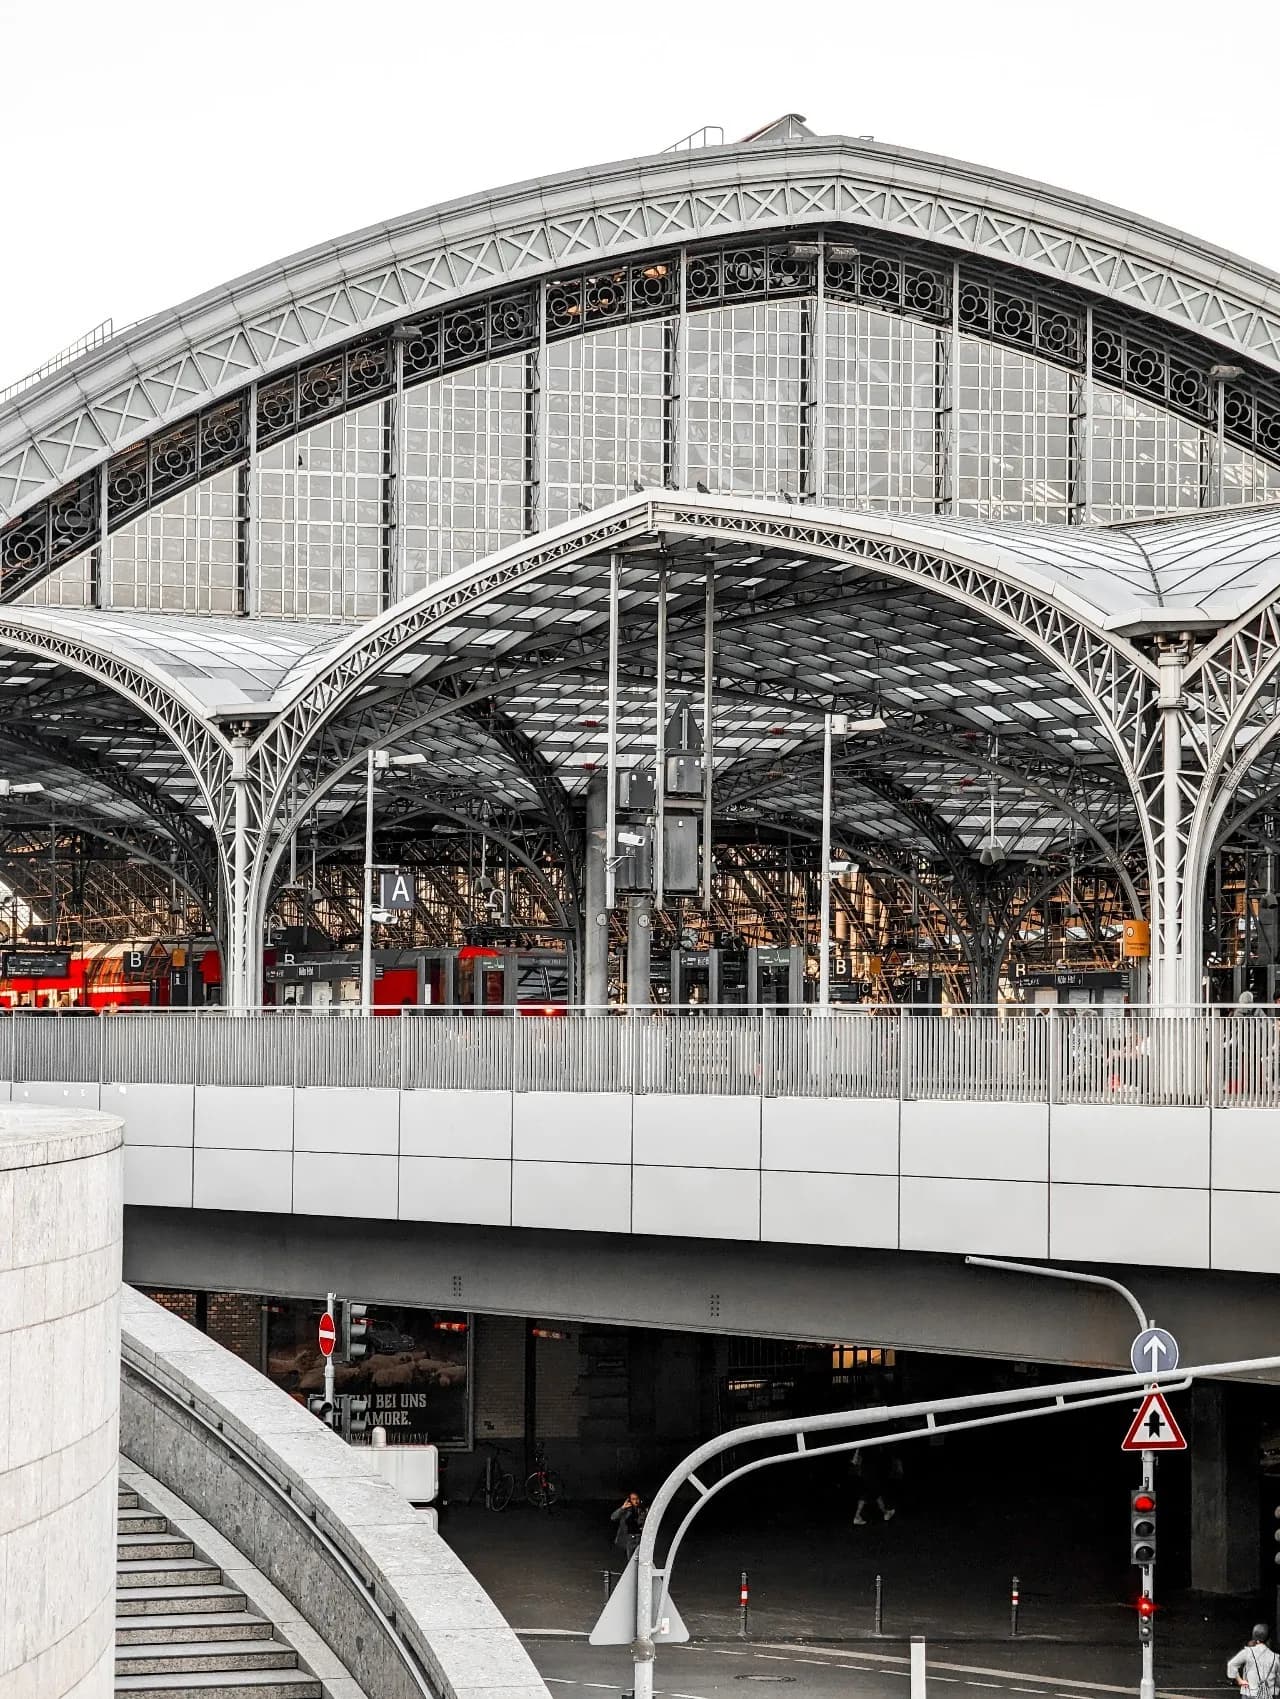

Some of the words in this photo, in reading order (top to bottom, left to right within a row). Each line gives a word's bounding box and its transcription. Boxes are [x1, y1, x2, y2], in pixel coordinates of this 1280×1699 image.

[391, 875, 410, 902] A
[130, 951, 142, 967] B
[835, 959, 846, 975] B
[375, 1393, 397, 1409] BEI
[400, 1393, 427, 1408] UNS
